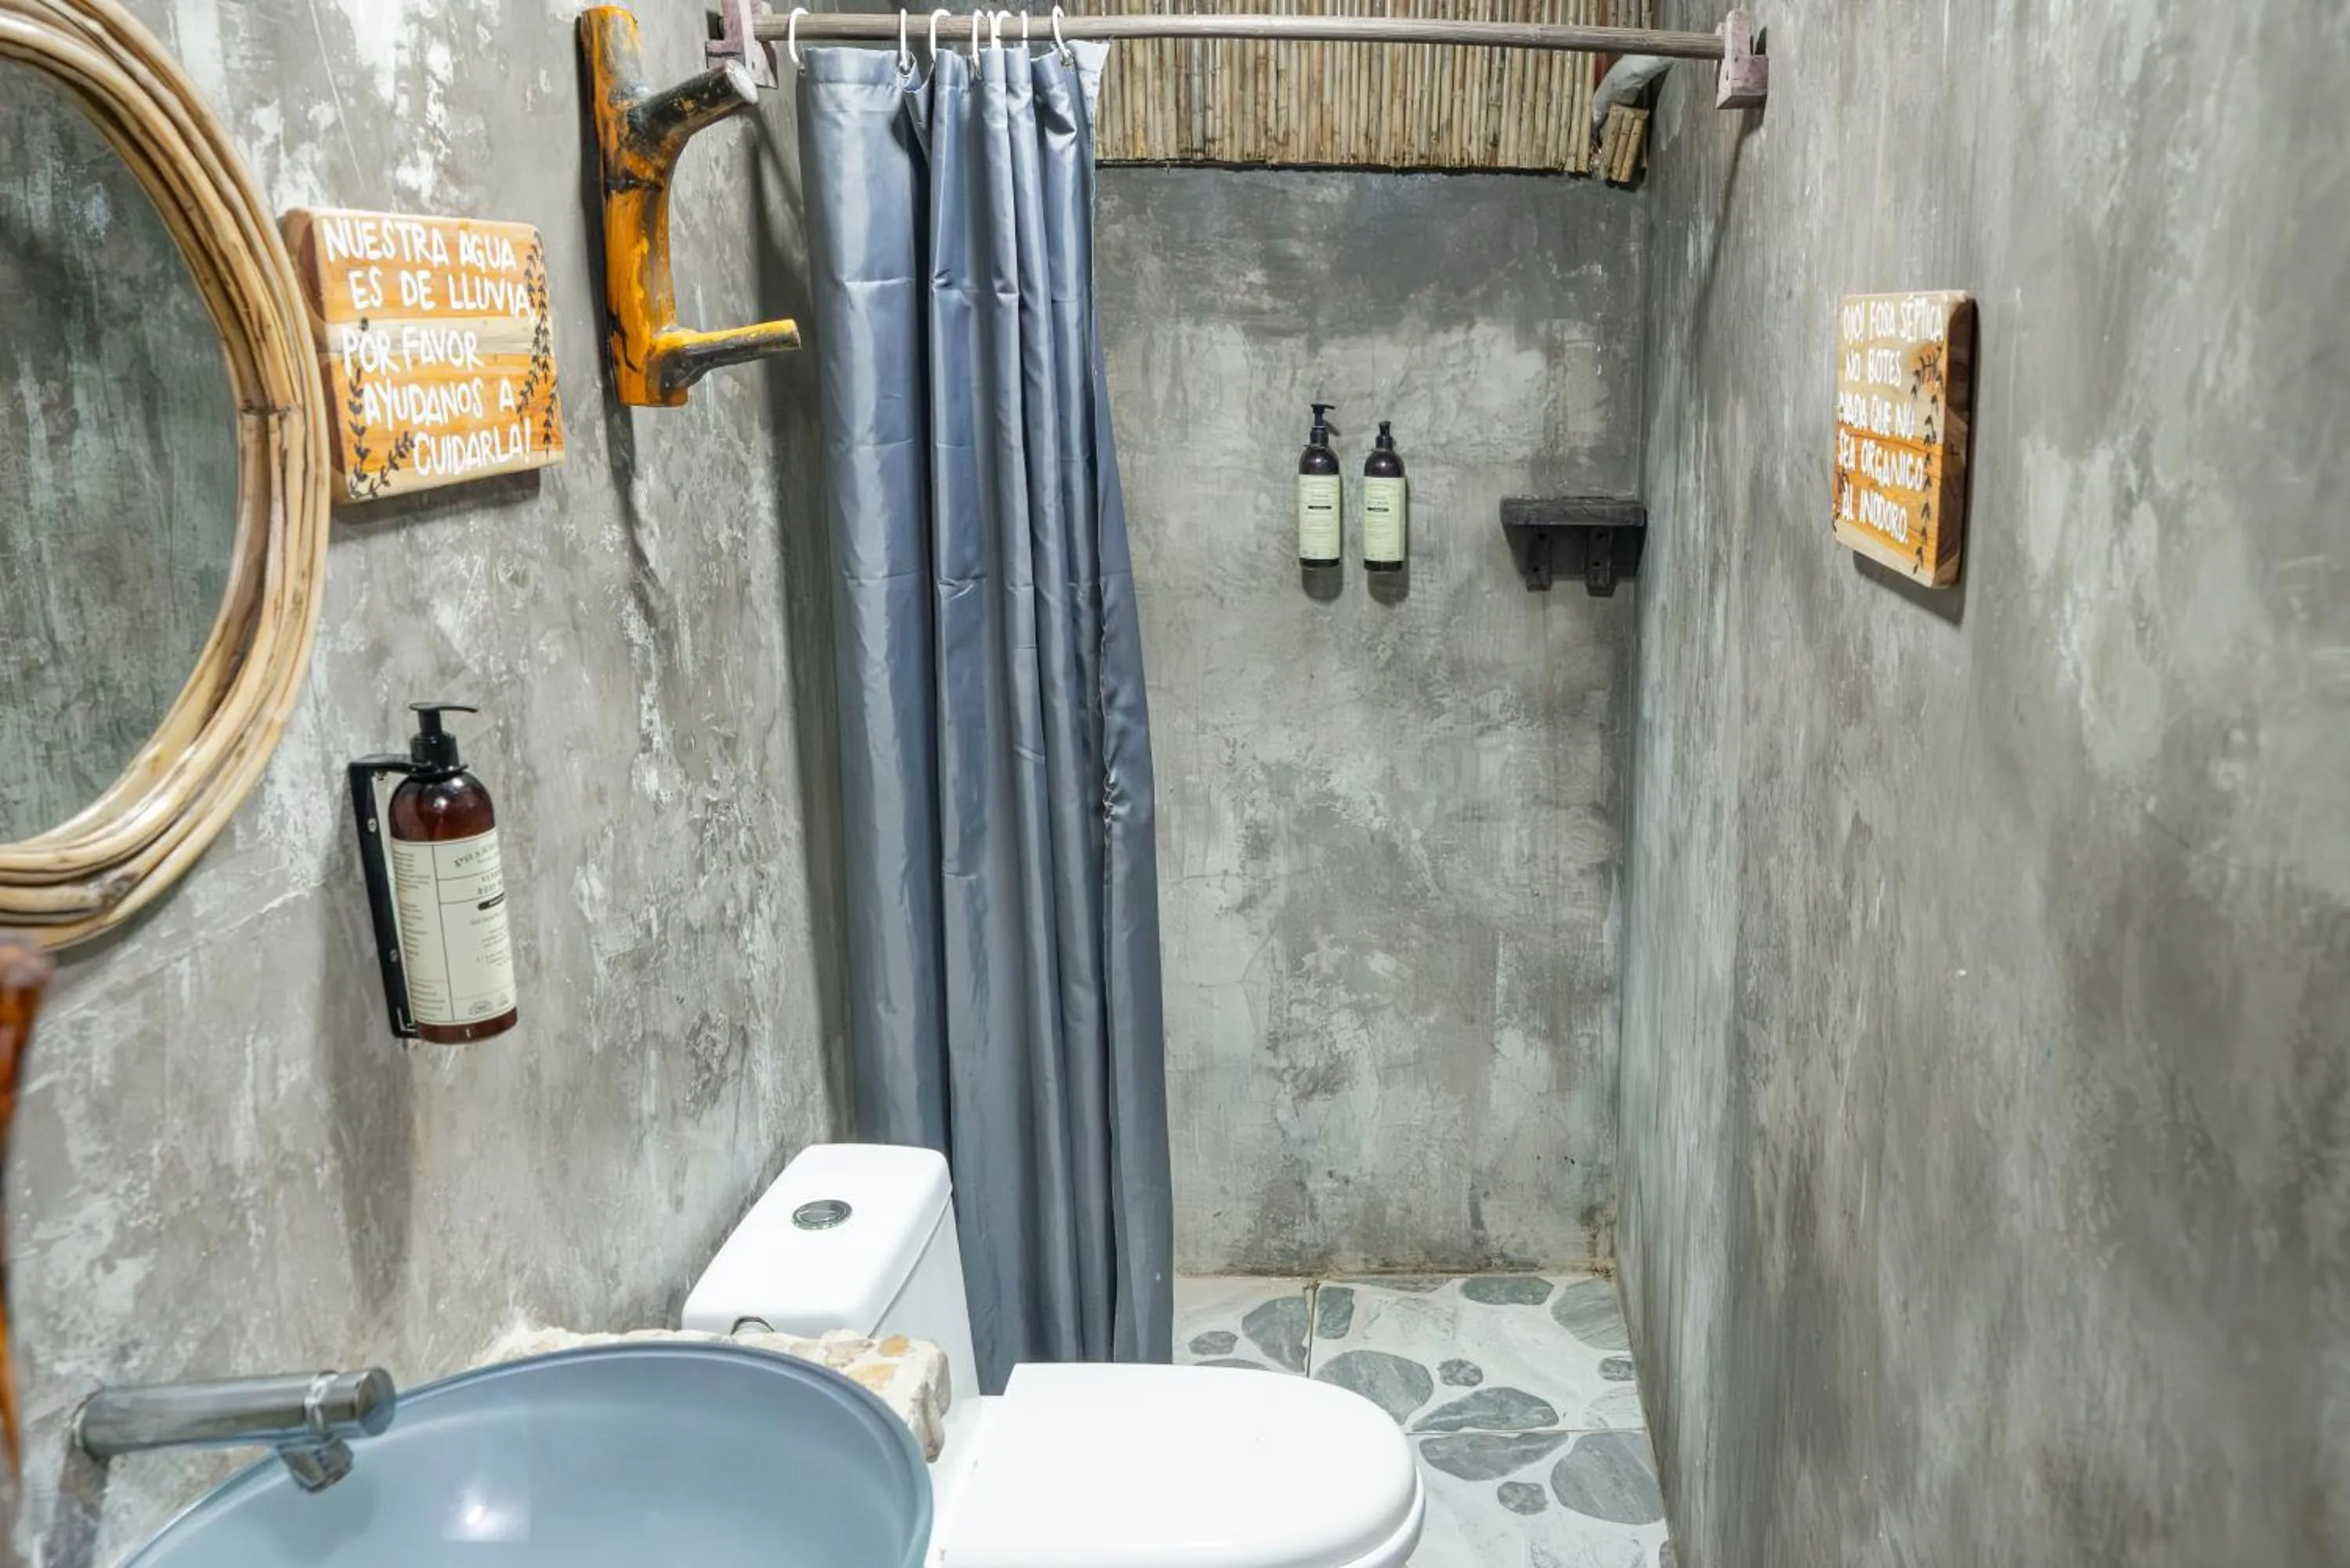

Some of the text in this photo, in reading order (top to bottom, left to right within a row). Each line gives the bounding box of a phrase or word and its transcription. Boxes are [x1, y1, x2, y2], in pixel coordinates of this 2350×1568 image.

[323, 219, 516, 273] NUESTRA AGUA
[349, 268, 382, 309] ES
[400, 271, 435, 310] DE
[342, 327, 483, 375] POR FAVOR
[1846, 350, 1902, 386] NO BOTES
[363, 378, 515, 430] AYUDANOS A
[1871, 396, 1890, 435] QUE
[1896, 400, 1914, 439] NO
[414, 418, 530, 475] CUIDARLA!
[1839, 429, 1924, 491] SEA ORGANICO
[1842, 482, 1854, 520] AL
